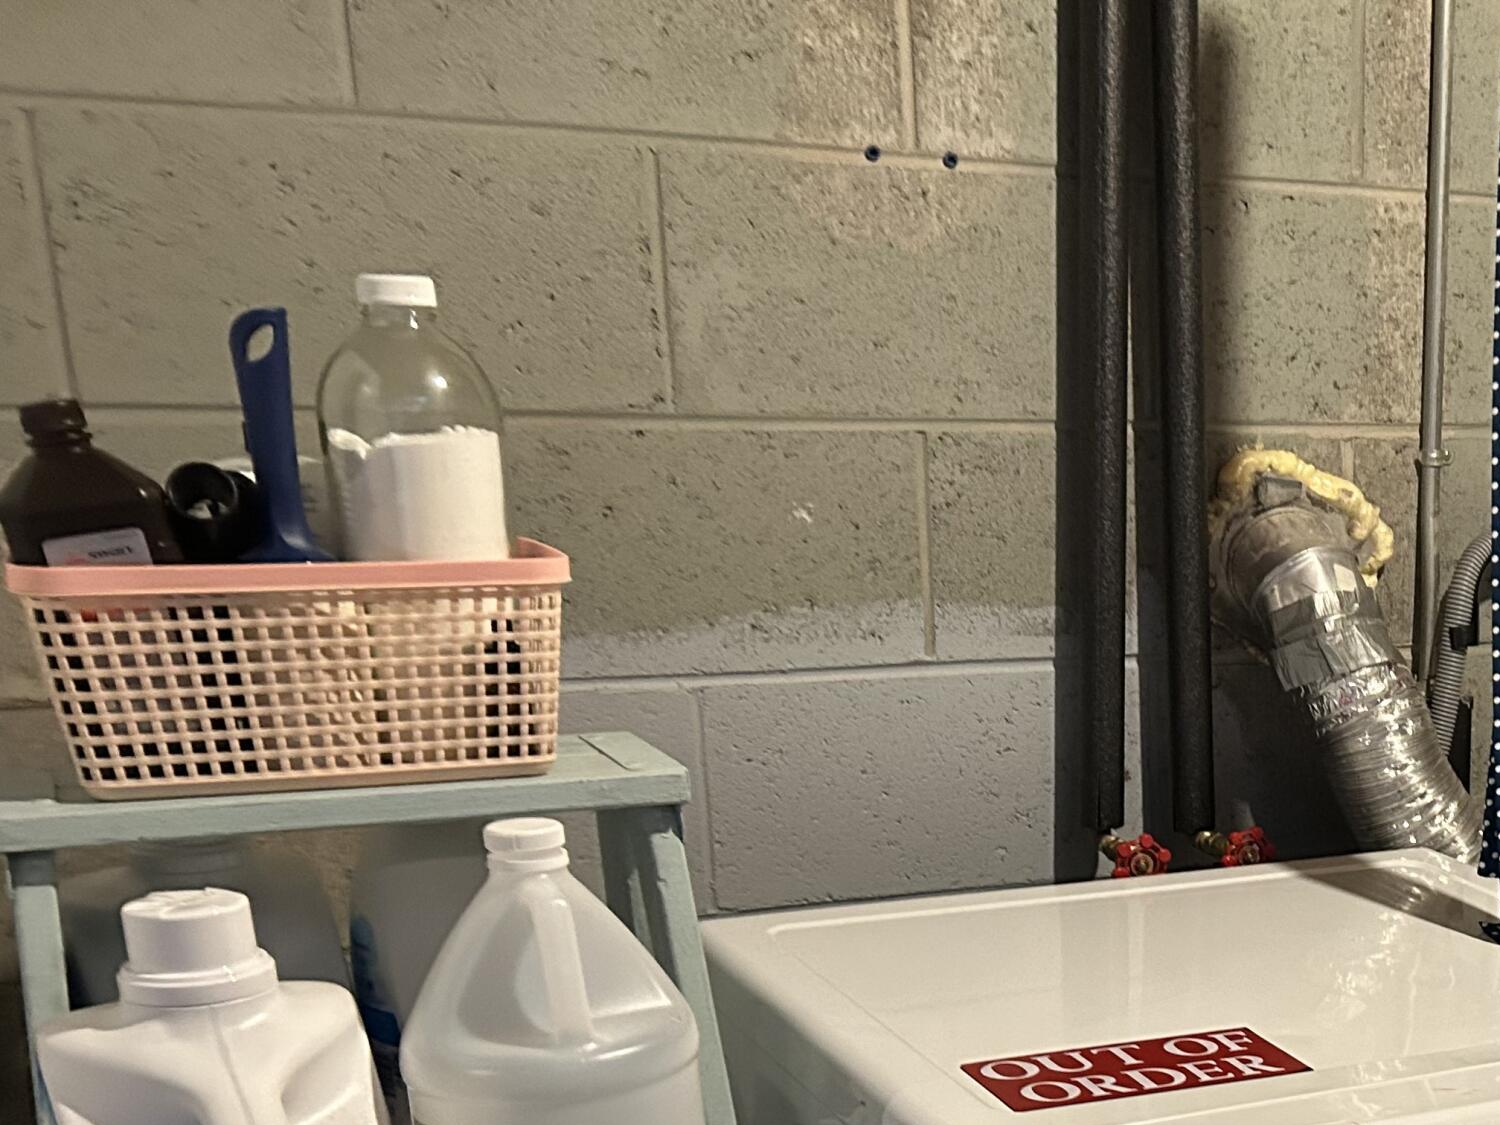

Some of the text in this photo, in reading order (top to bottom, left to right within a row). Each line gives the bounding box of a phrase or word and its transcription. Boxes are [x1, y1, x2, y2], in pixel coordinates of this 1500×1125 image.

[980, 1030, 1254, 1082] OUT OF
[1020, 1054, 1286, 1103] ORDER
